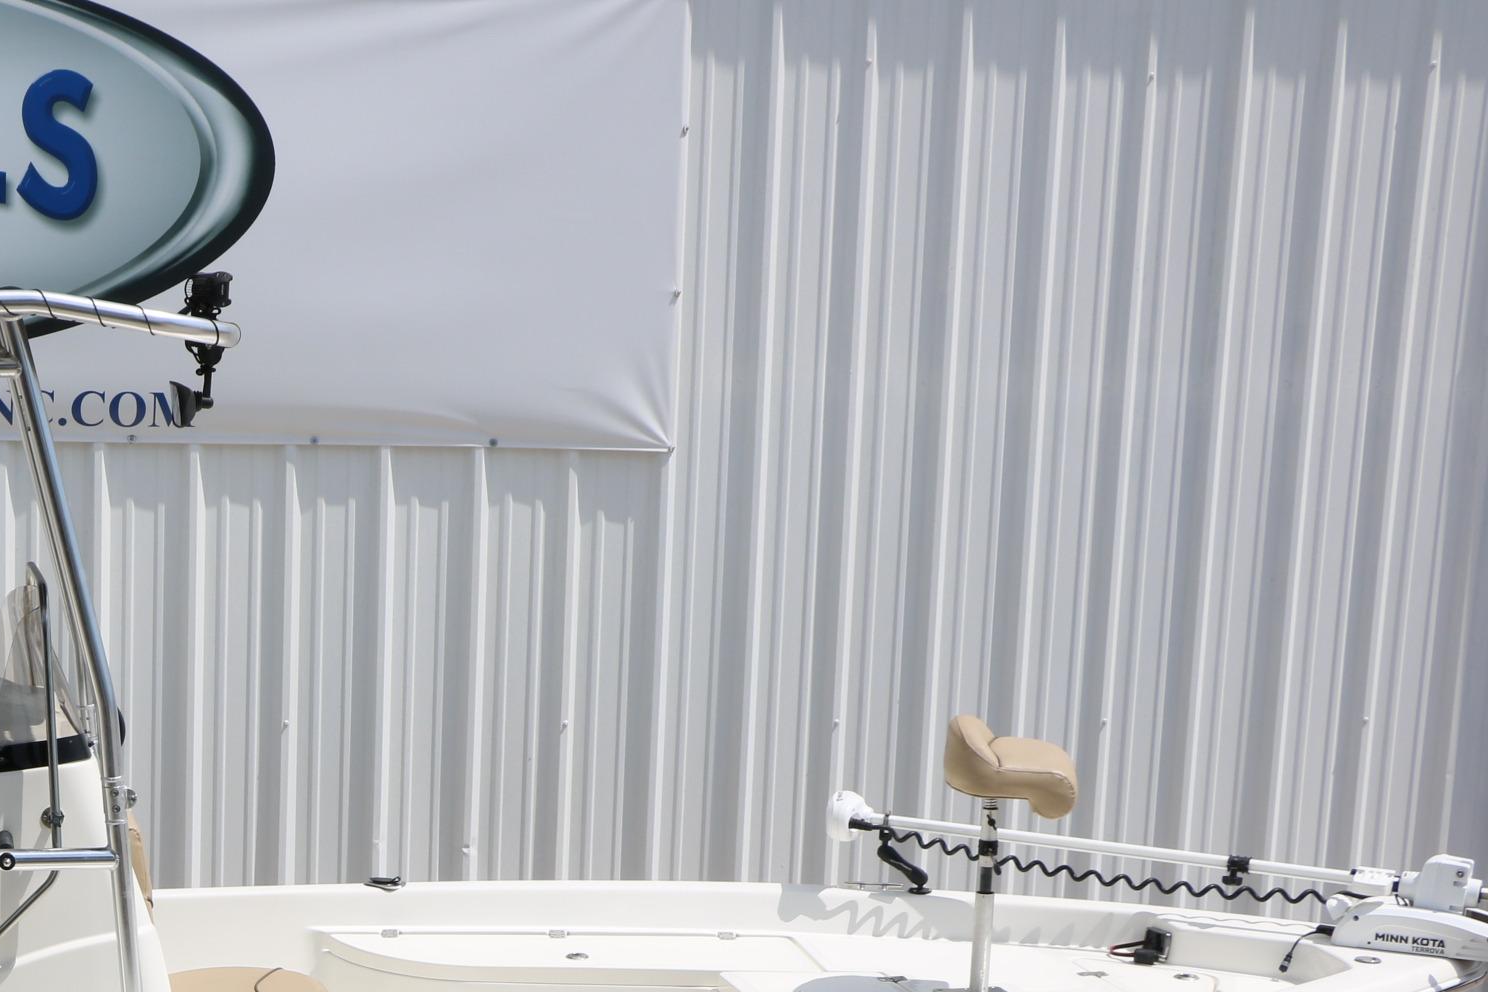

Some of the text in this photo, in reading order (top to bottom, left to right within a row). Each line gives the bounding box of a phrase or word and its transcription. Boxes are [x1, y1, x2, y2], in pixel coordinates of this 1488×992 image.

[1374, 932, 1446, 949] MINN KOTA
[1412, 945, 1445, 955] TERROVA
